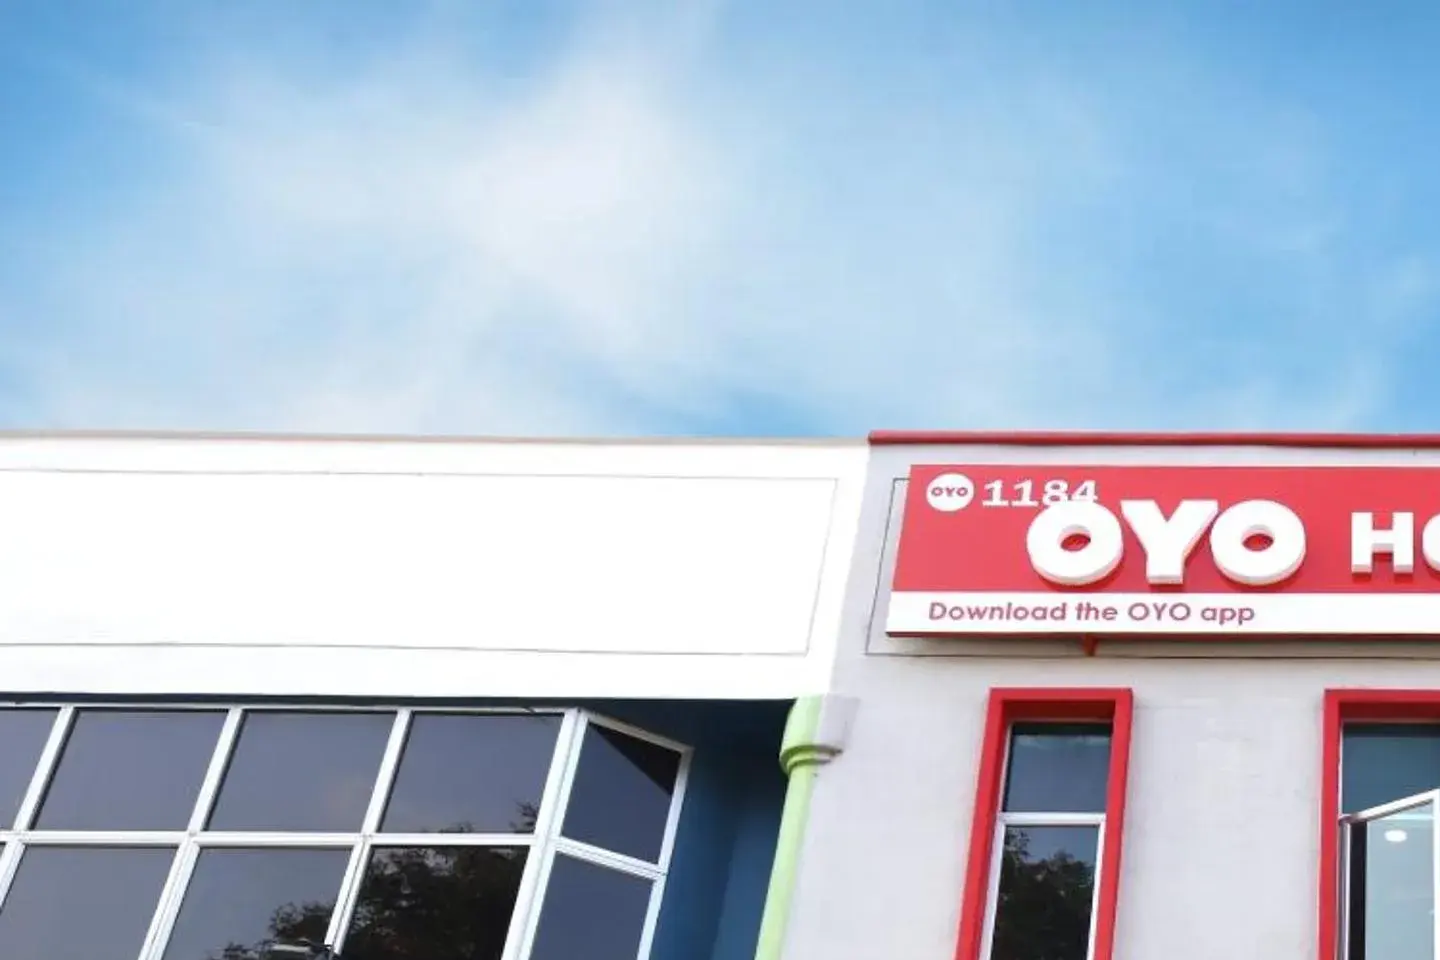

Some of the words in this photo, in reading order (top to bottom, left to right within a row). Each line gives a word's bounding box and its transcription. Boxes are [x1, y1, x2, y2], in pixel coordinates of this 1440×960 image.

[931, 486, 968, 498] OYO
[982, 479, 1099, 507] 1184
[1026, 499, 1306, 586] OYO
[928, 602, 1067, 621] Download
[1075, 602, 1118, 621] the
[1128, 602, 1191, 621] OYO
[1200, 605, 1255, 626] app
